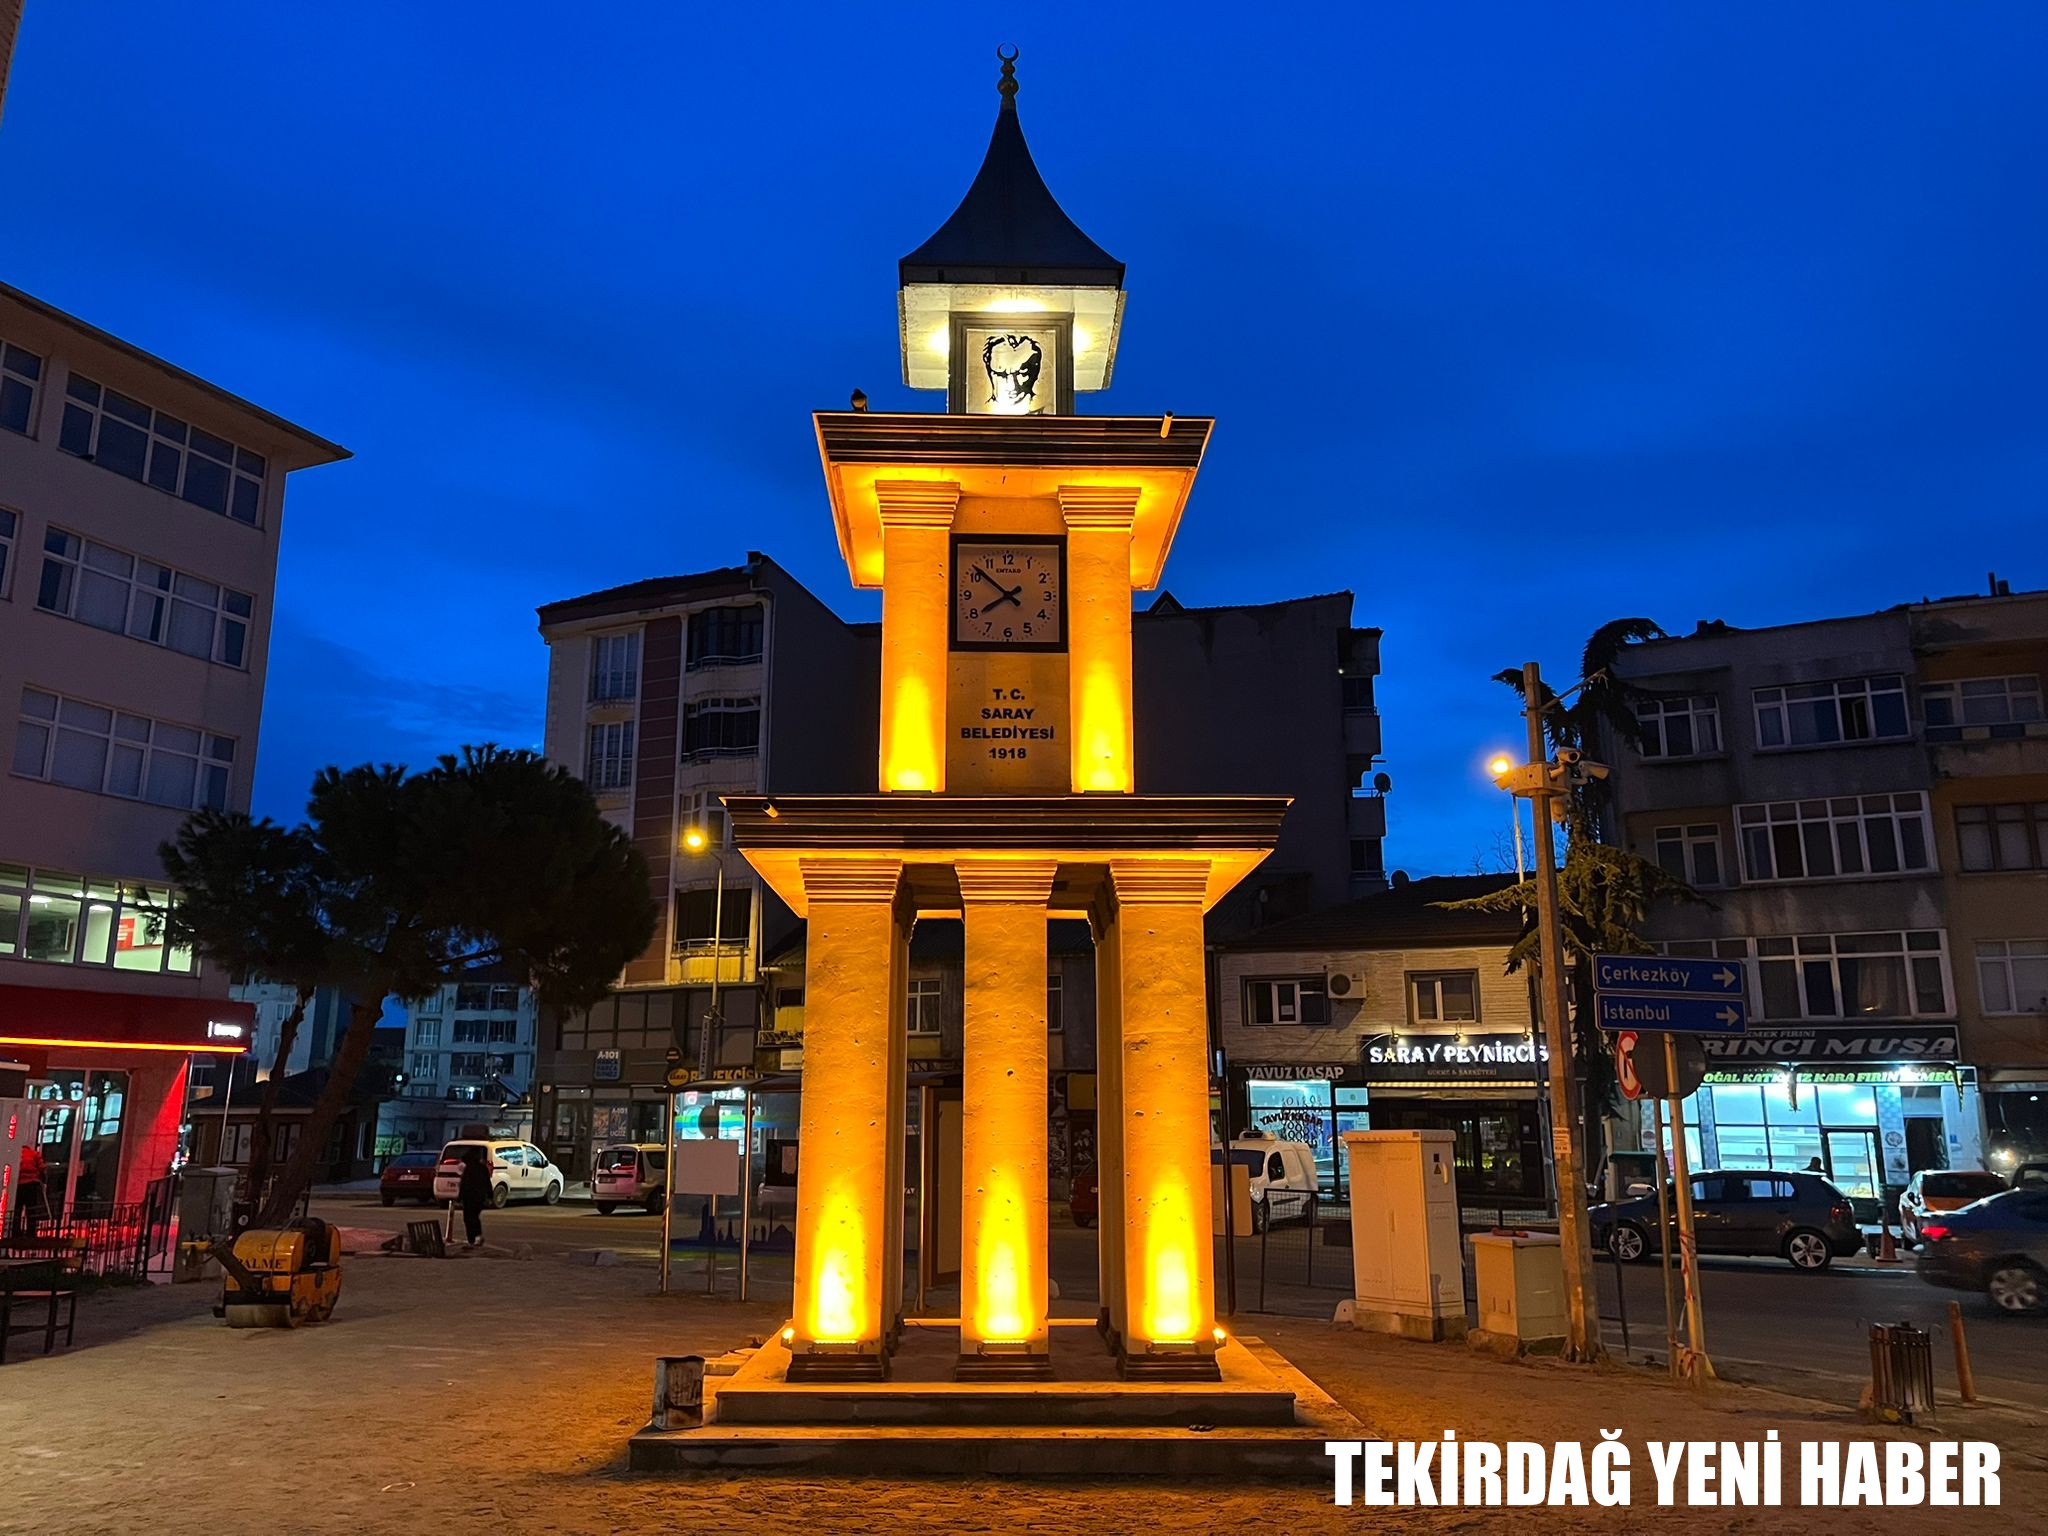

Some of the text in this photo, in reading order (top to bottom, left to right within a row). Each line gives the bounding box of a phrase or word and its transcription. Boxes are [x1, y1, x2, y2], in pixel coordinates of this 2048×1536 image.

[986, 559, 993, 569] 11
[1003, 554, 1013, 565] 12
[1027, 559, 1031, 569] 1
[970, 573, 981, 582] 10
[1039, 573, 1046, 583] 2
[964, 590, 971, 600] 9
[1044, 592, 1051, 601] 3
[970, 608, 978, 619] 8
[1037, 609, 1046, 619] 4
[985, 622, 992, 632] 7
[1004, 628, 1012, 637] 6
[1024, 623, 1032, 633] 5
[981, 708, 1034, 719] SARAY
[961, 725, 1054, 739] BELEDİYESİ
[989, 748, 1026, 759] 1918
[1602, 966, 1690, 987] Çerkezköy
[1604, 1001, 1670, 1021] İstanbul
[1369, 1041, 1549, 1064] SARAY PEYNİRCİS
[1701, 1038, 1955, 1056] RINCI MUSA
[1246, 1066, 1345, 1079] YAVUZ KASAP
[1703, 1072, 1740, 1083] OĞAL
[1813, 1072, 1855, 1083] KARA
[1856, 1072, 1898, 1082] FIRIN
